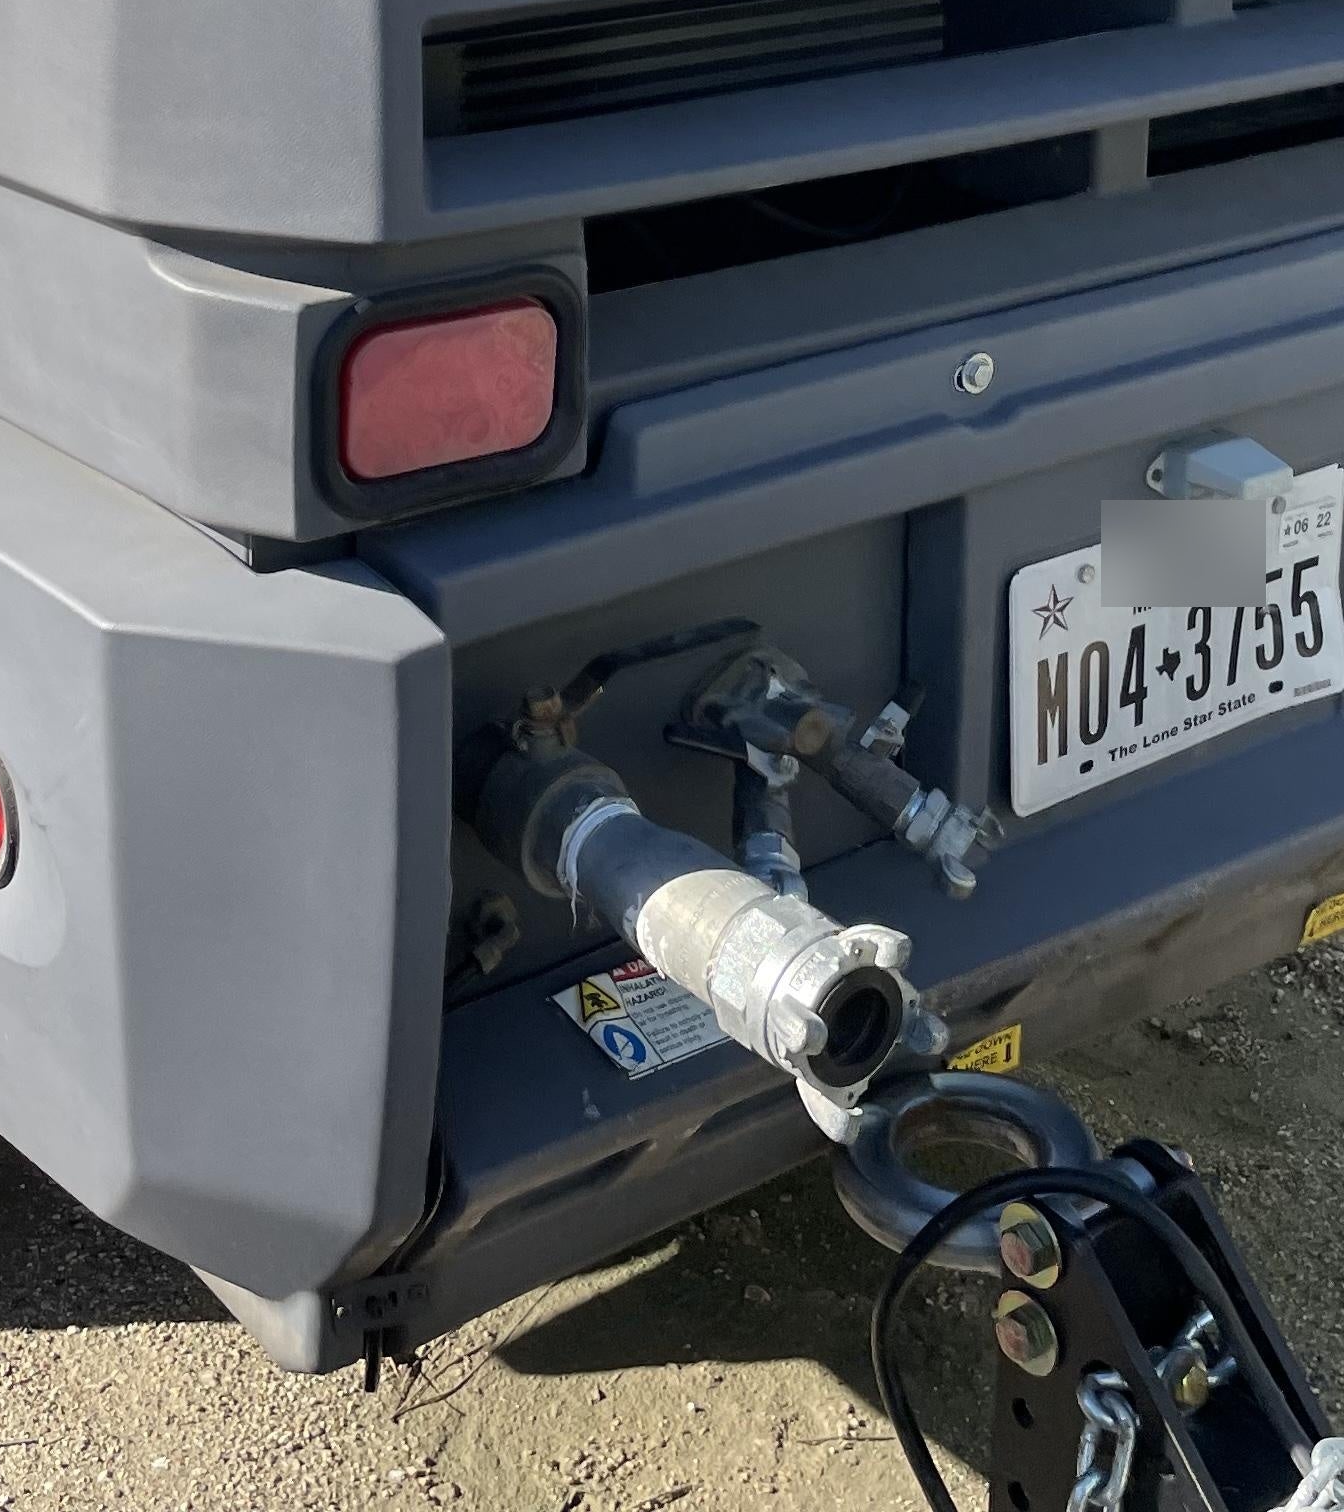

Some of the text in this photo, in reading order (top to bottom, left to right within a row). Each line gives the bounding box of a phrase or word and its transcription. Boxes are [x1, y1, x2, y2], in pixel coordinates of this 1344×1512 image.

[1316, 511, 1331, 529] 22
[1108, 692, 1257, 762] The Lone Star State
